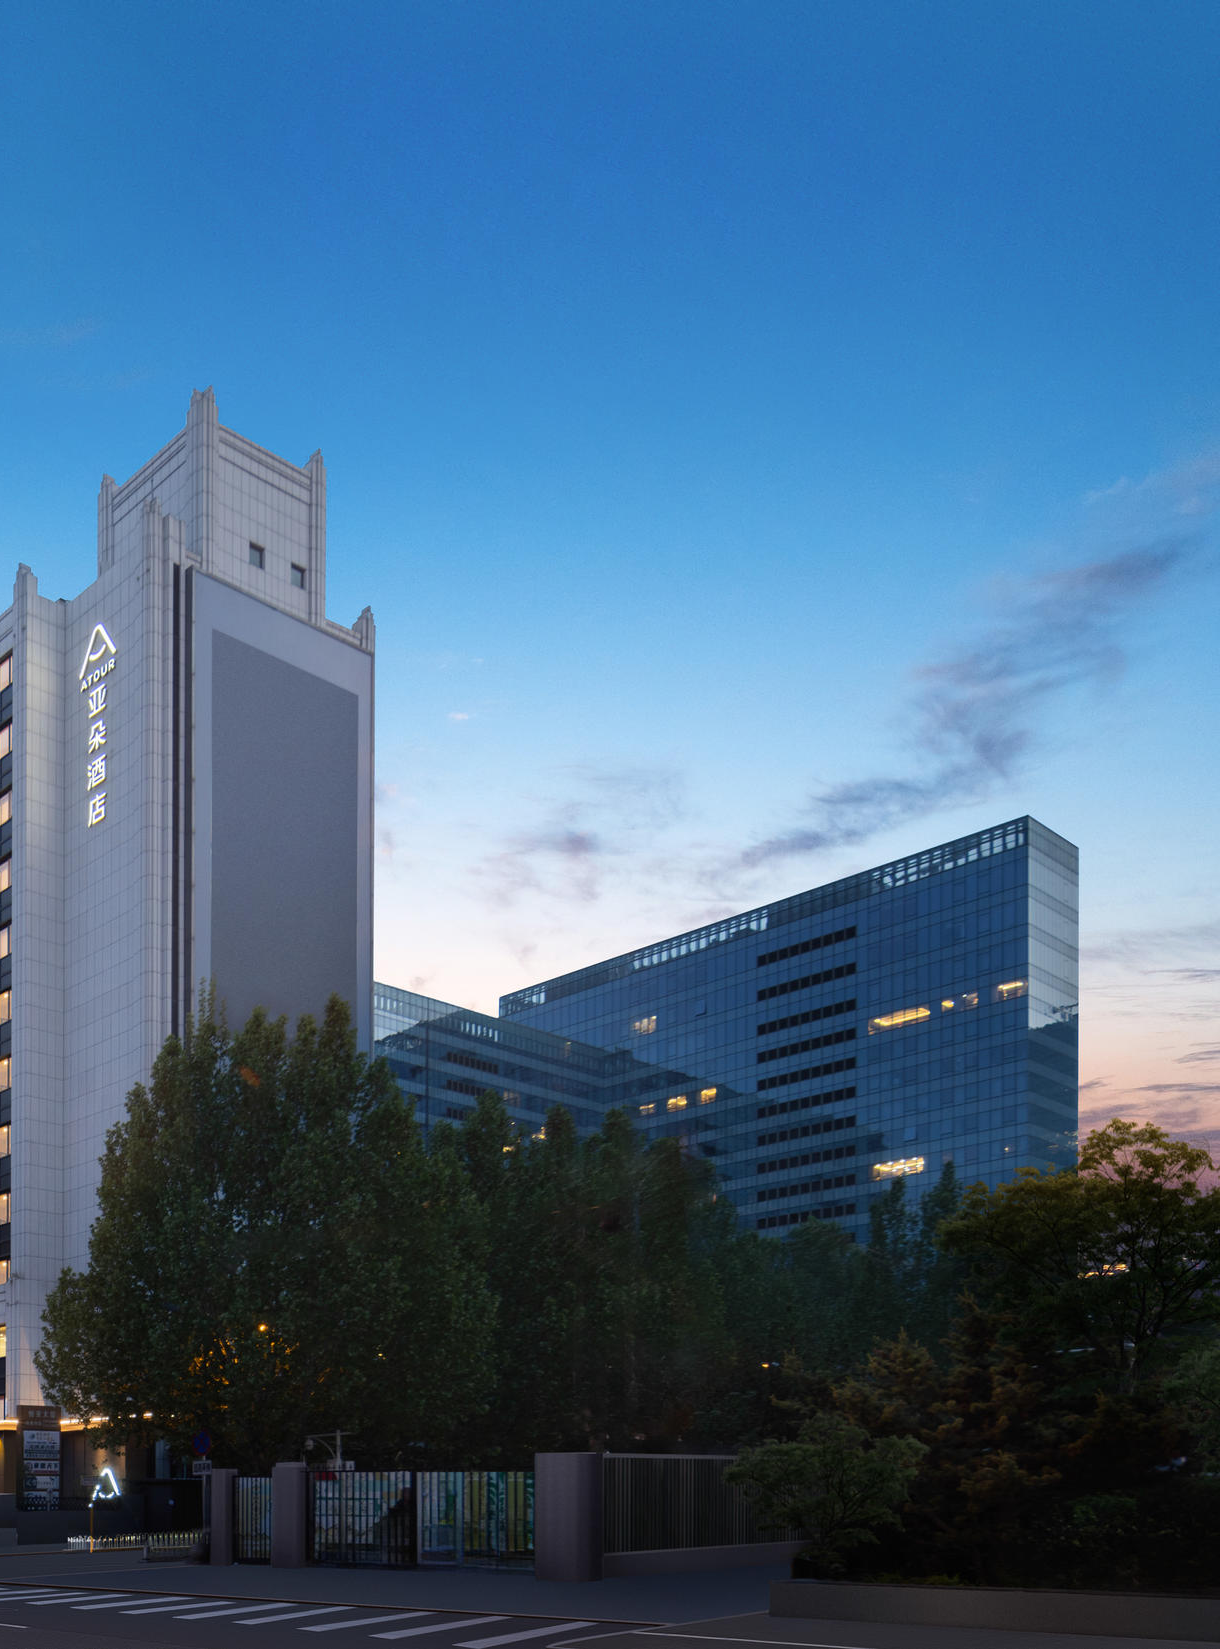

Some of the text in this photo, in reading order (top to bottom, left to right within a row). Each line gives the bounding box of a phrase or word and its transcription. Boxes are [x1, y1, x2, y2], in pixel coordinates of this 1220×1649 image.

[81, 658, 116, 692] ATOUR
[87, 683, 107, 828] 亚朵酒店
